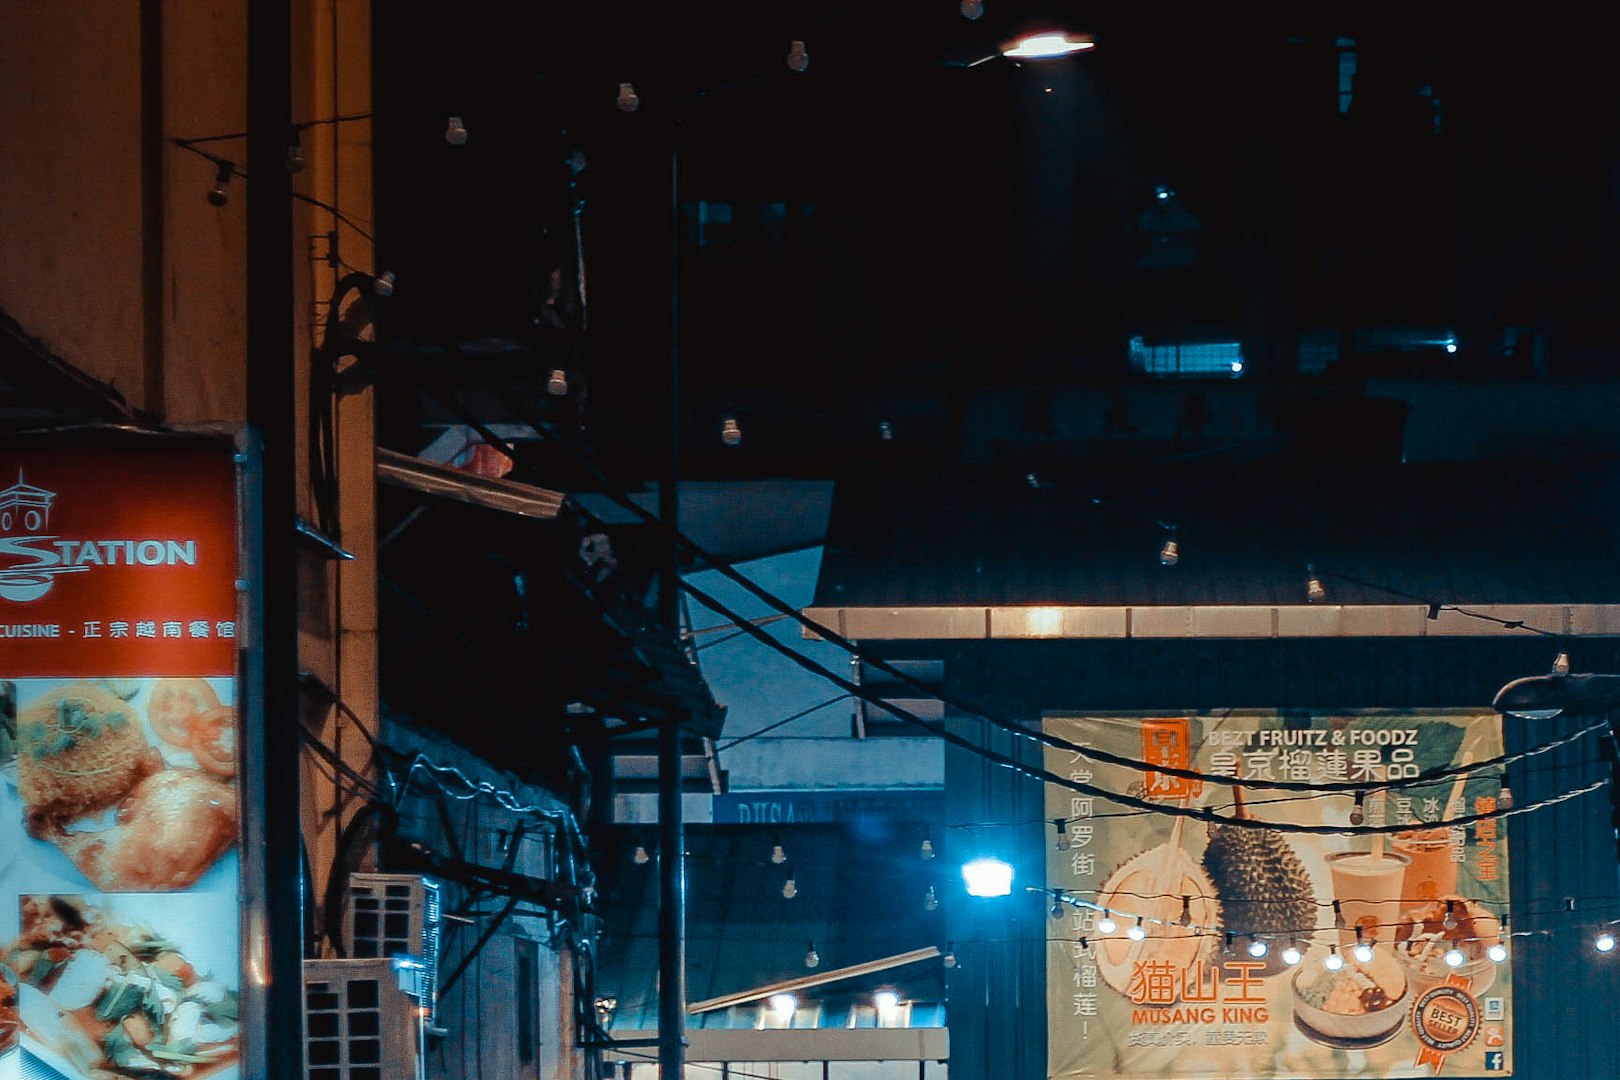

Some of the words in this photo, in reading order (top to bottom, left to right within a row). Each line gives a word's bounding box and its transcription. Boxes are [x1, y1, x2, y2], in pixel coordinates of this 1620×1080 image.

[83, 621, 236, 639] 正宗越南餐馆
[1208, 730, 1255, 746] BEZT
[1260, 729, 1328, 746] FRUITZ
[1331, 730, 1346, 746] &
[1350, 729, 1419, 746] FOODZ
[1130, 959, 1267, 1005] 猫山王
[1132, 1008, 1215, 1024] MUSANG
[1222, 1007, 1269, 1024] KING
[1431, 1008, 1462, 1027] BEST
